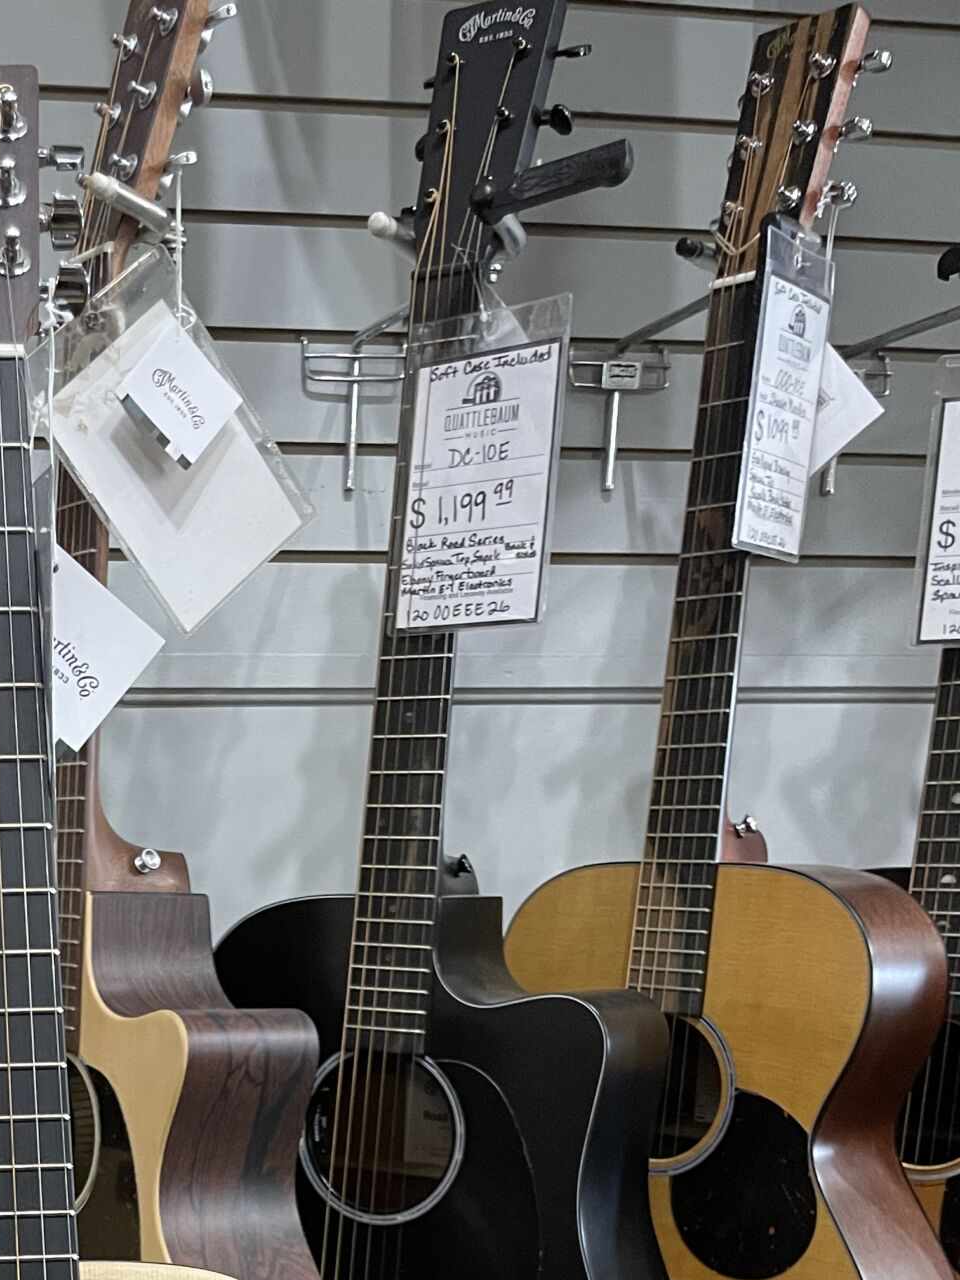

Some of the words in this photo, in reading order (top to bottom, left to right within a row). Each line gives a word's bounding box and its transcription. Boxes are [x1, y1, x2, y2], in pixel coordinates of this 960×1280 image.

[430, 365, 459, 383] Soft
[491, 345, 552, 369] Included
[444, 403, 520, 432] QUATTLEBAUM
[465, 428, 497, 439] MUSIC
[448, 441, 510, 468] DC-10E
